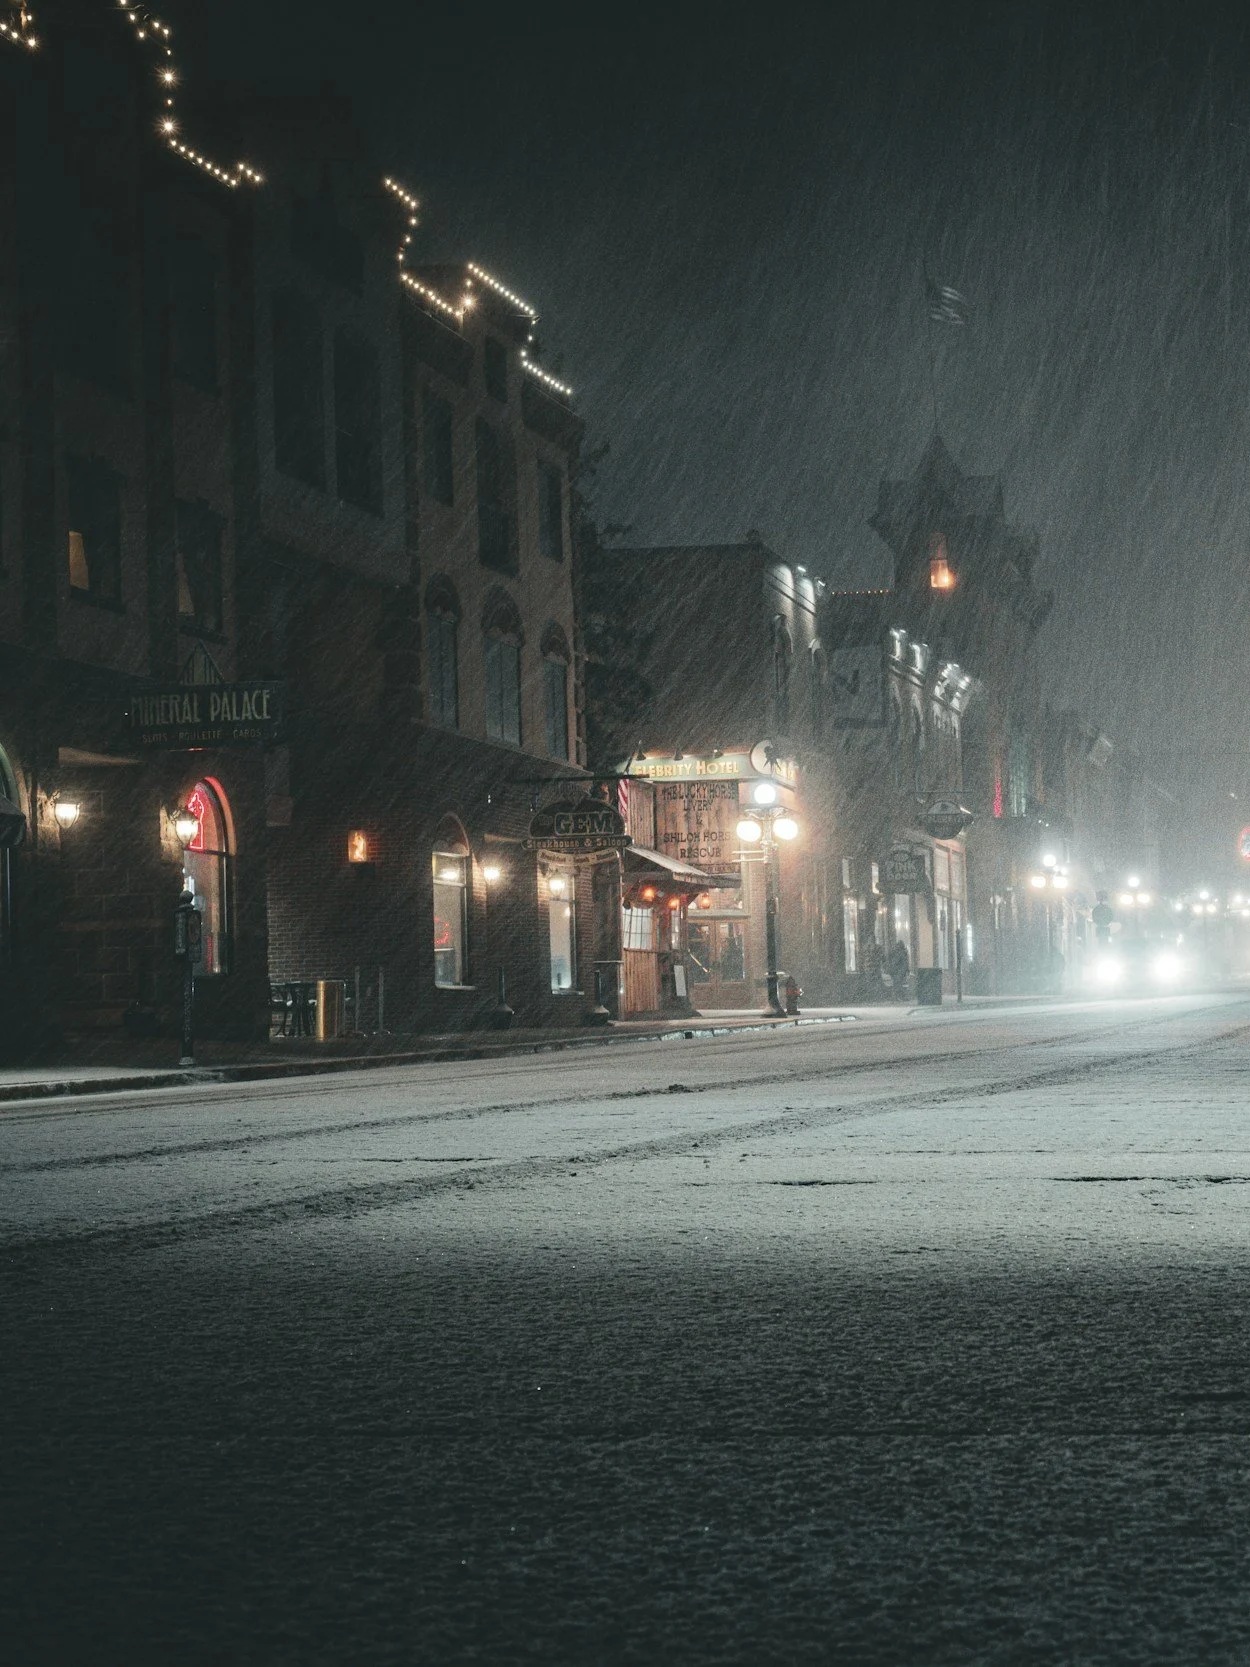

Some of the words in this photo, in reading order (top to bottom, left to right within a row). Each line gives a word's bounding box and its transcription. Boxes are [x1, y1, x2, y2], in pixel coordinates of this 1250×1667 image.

[131, 693, 200, 727] MINERAL
[210, 690, 271, 721] PALACE
[632, 763, 692, 777] ELEBRITY
[696, 760, 739, 775] HOTEL
[678, 783, 707, 800] LUCKY
[555, 811, 614, 836] GEM
[703, 830, 731, 841] HORS
[680, 848, 722, 859] RESCUE
